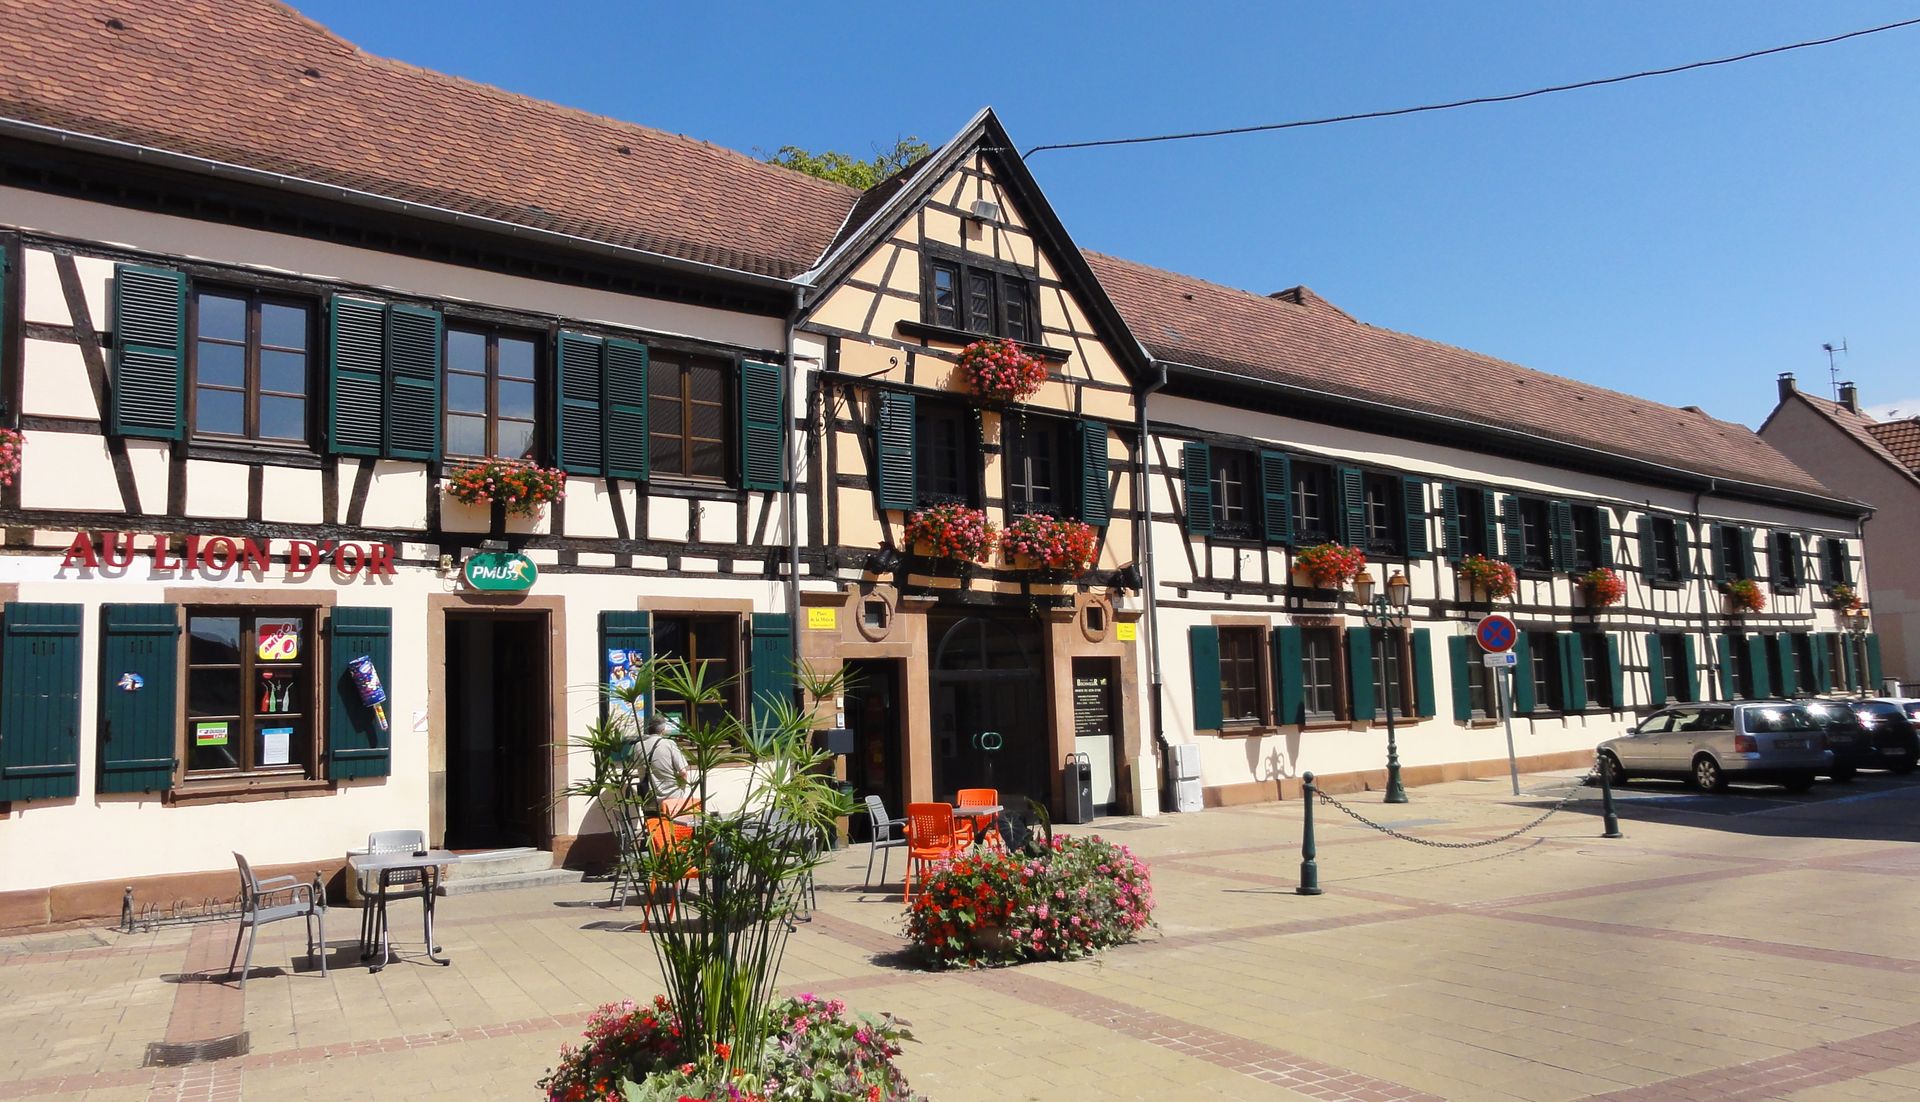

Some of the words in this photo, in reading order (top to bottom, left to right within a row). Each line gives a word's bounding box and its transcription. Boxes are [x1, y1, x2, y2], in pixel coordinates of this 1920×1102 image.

[61, 530, 138, 568] AU
[153, 533, 274, 573] LION
[287, 540, 398, 575] D'OR
[472, 565, 508, 580] PMU
